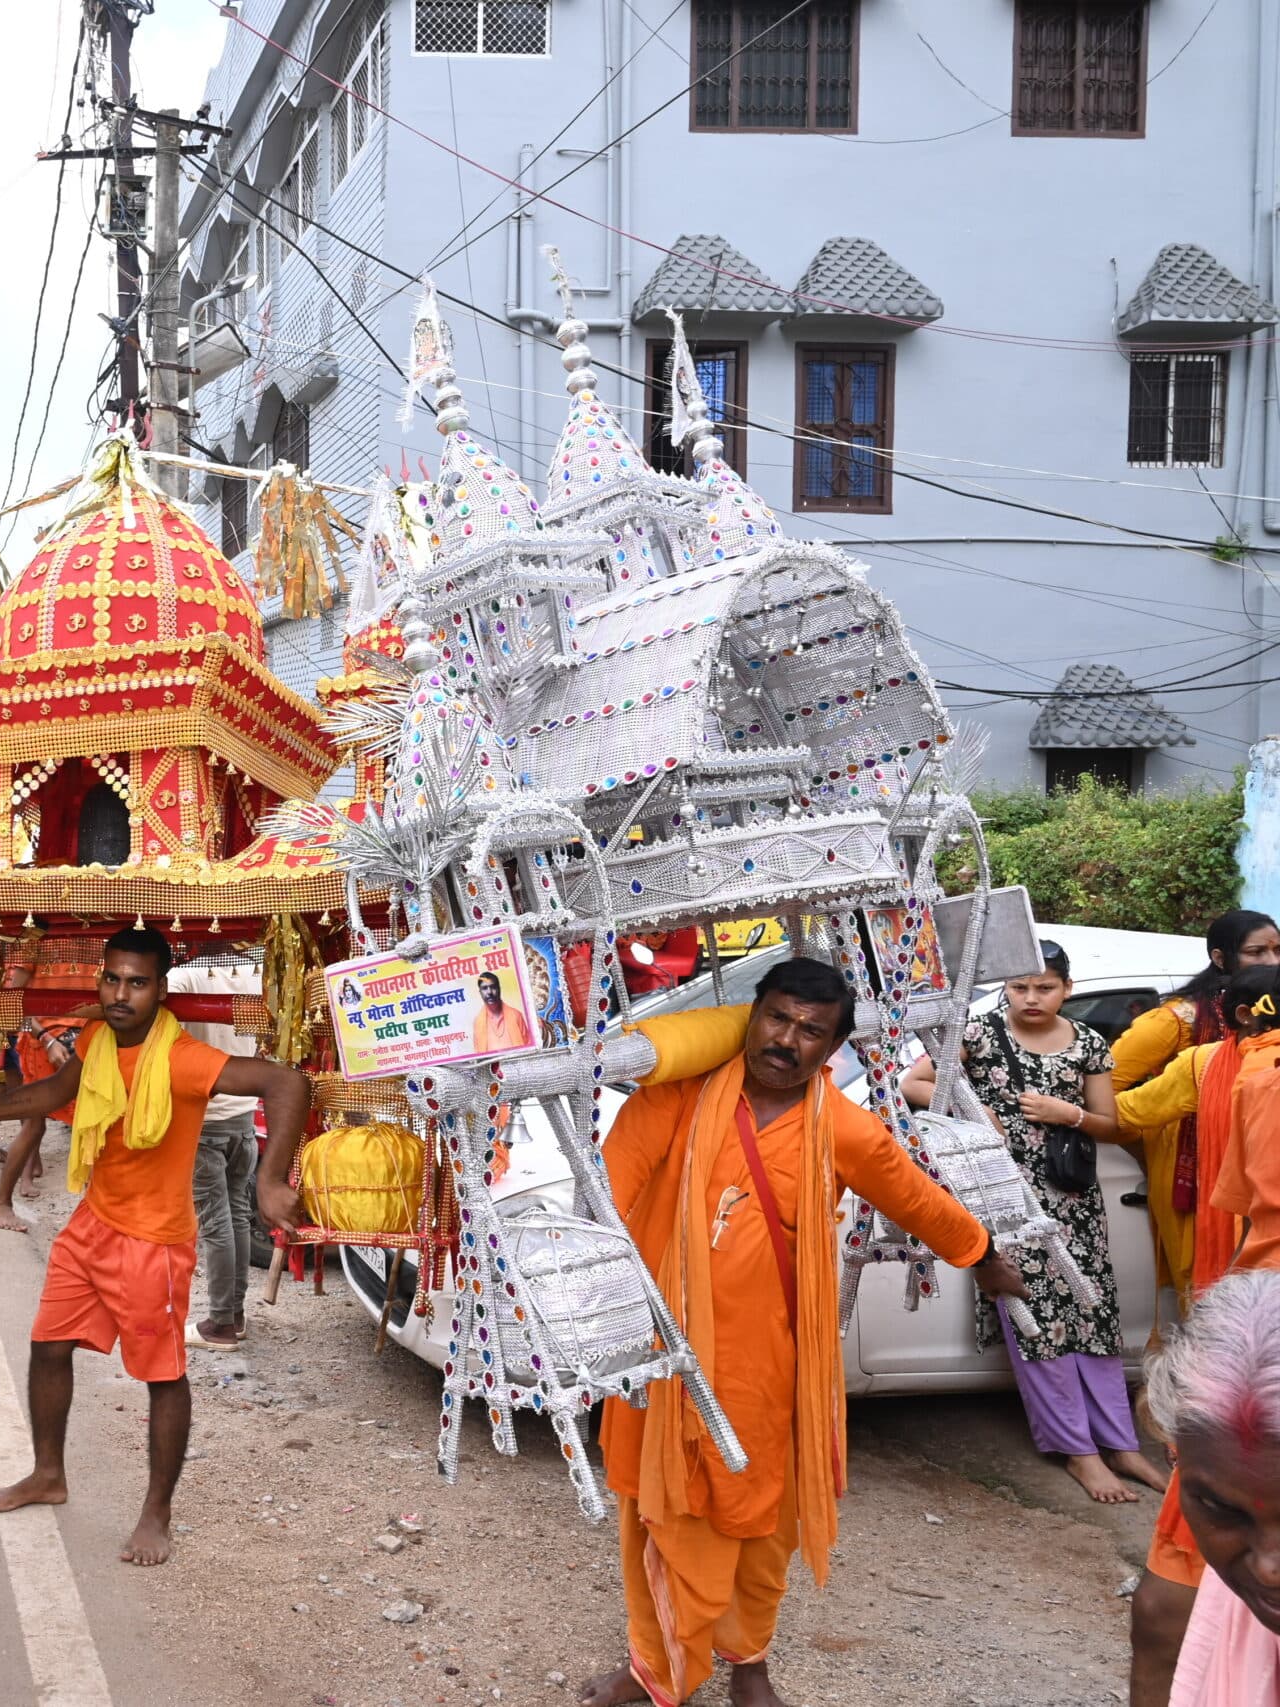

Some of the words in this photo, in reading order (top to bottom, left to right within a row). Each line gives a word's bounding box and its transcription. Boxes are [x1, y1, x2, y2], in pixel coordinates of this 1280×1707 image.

[483, 946, 510, 971] संघ
[347, 1011, 366, 1028] न्यू
[366, 1004, 395, 1020] मोना
[374, 1022, 408, 1040] प्रदीप
[411, 1013, 450, 1036] कुमार
